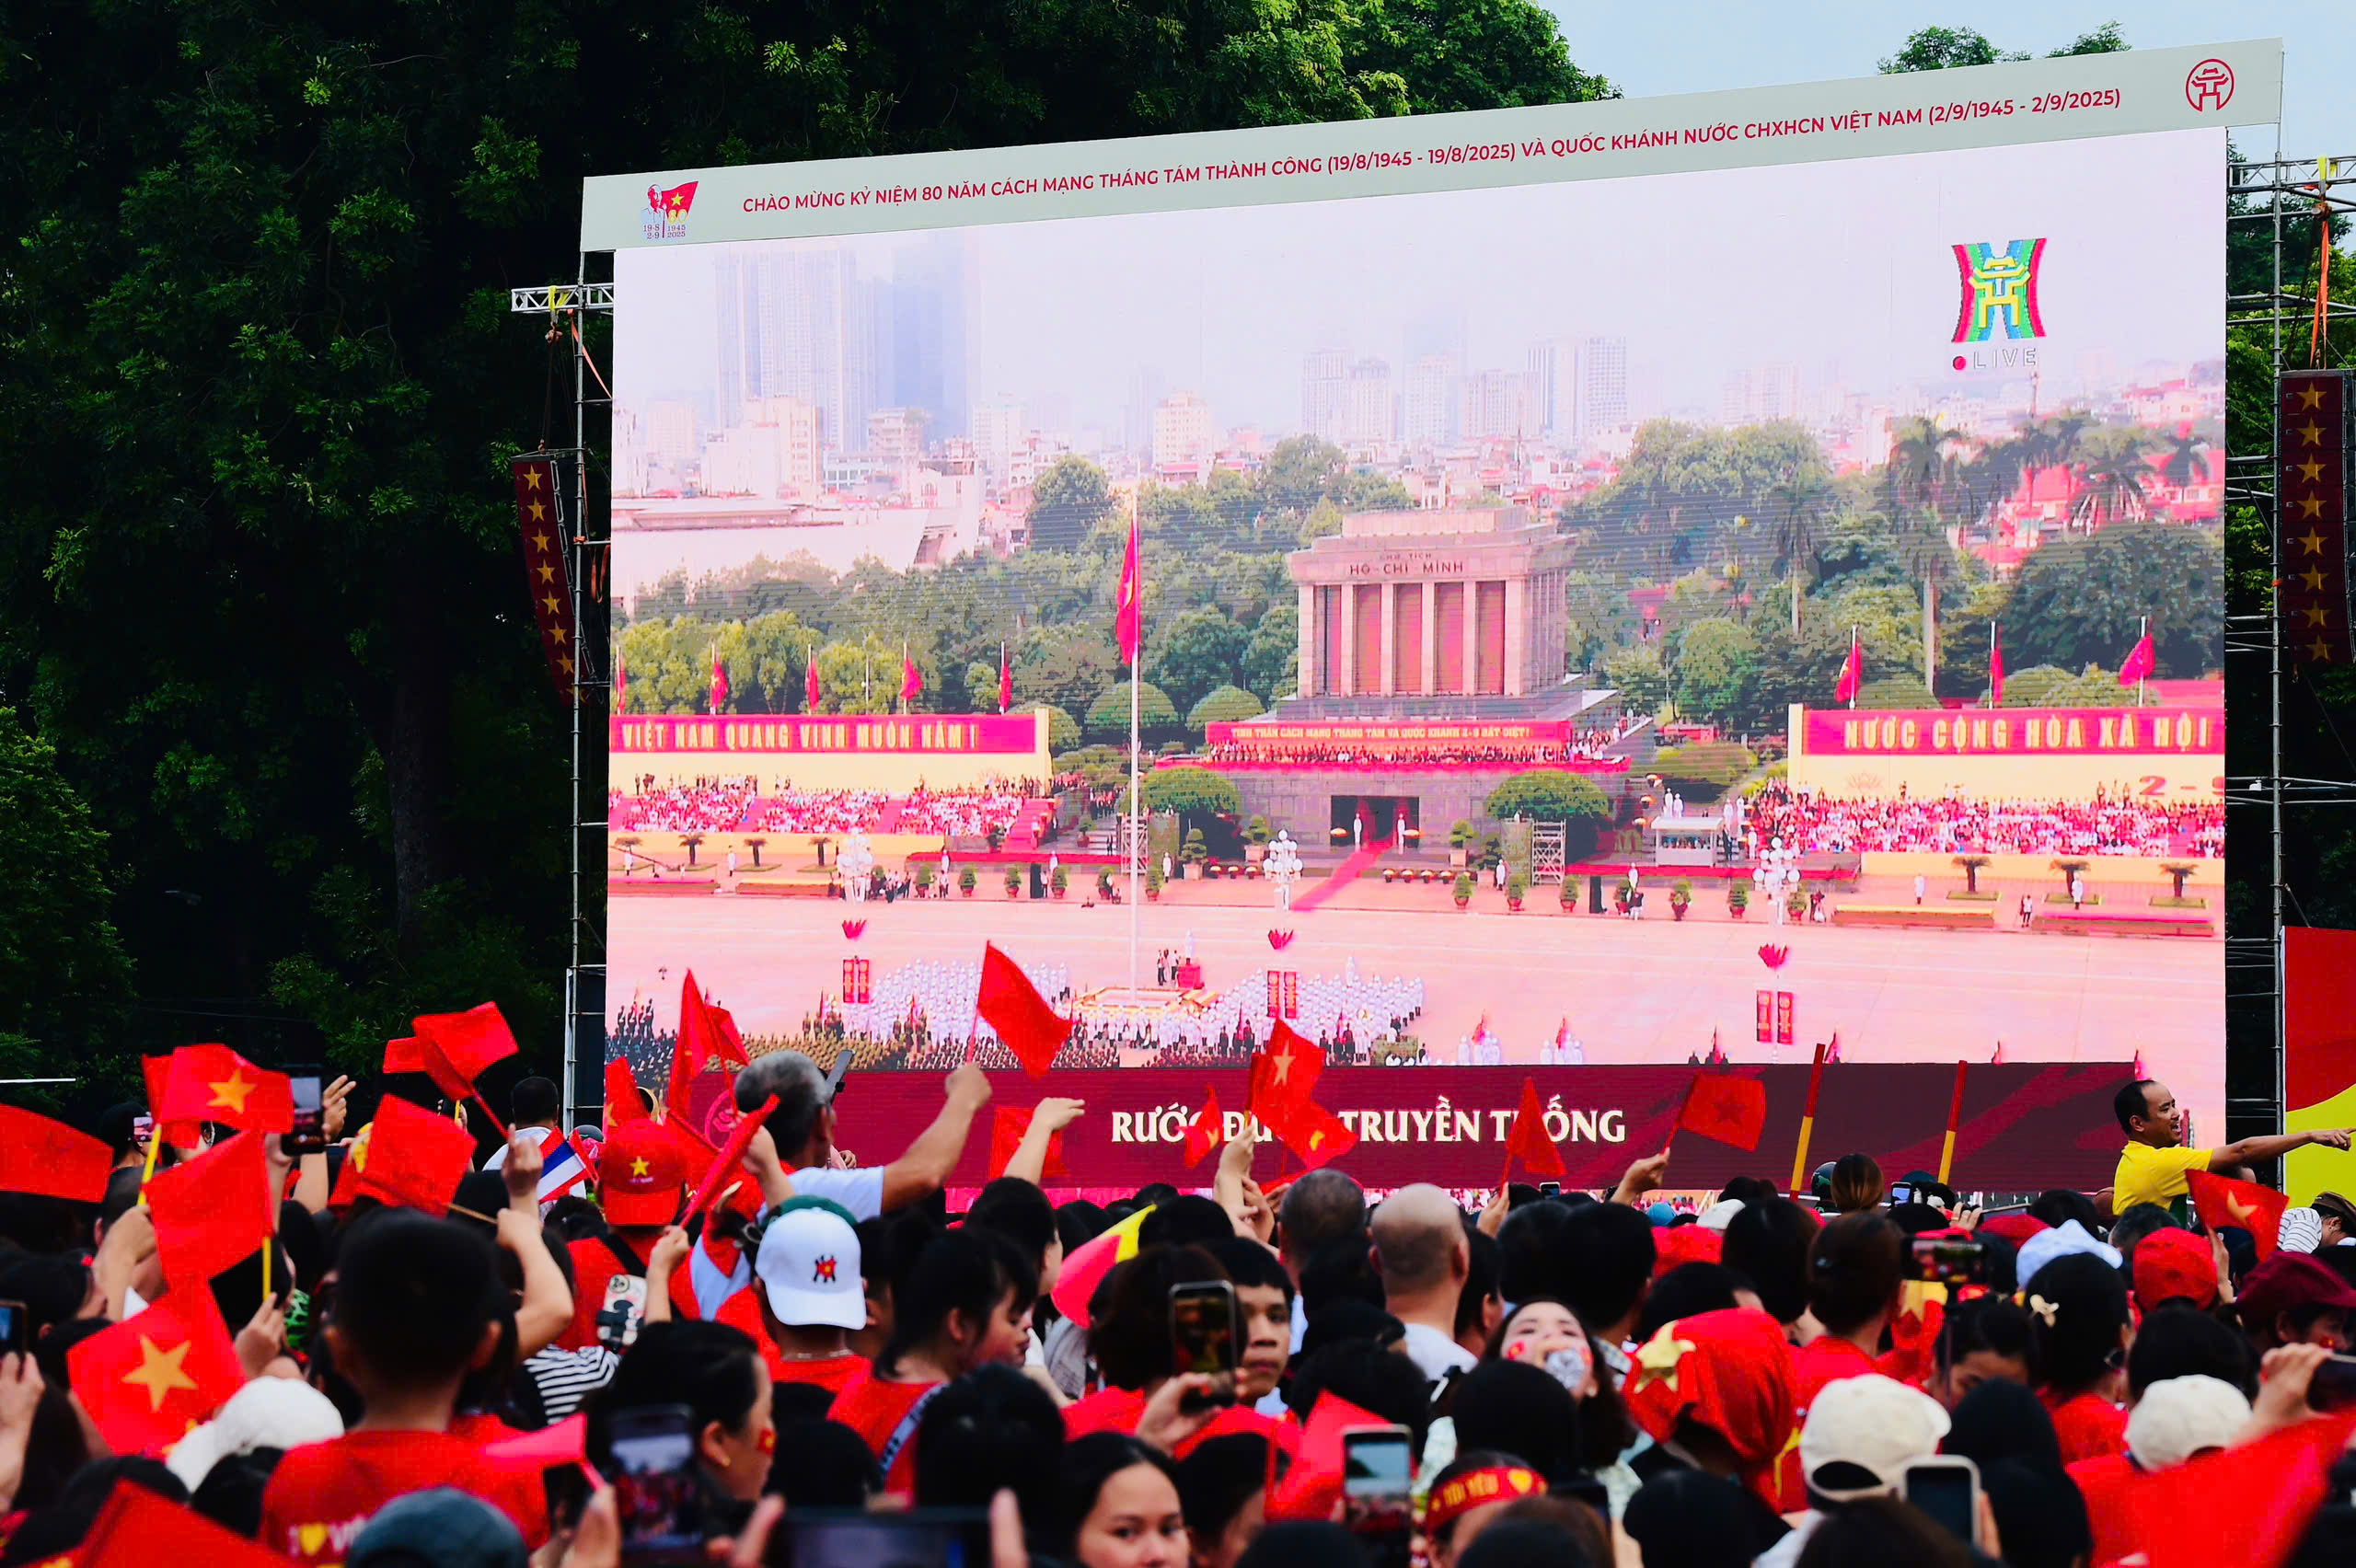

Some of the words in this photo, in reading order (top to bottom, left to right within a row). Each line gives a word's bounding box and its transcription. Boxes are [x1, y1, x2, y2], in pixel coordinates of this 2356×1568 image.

[743, 193, 791, 213] CHÀO
[795, 190, 845, 209] MỪNG
[850, 185, 872, 205] KỶ
[875, 184, 918, 206] NIỆM
[922, 185, 943, 202] 80
[948, 179, 986, 200] NĂM
[990, 177, 1037, 197] CÁCH
[1043, 174, 1094, 195] MẠNG
[1099, 168, 1159, 190] THÁNG
[1164, 164, 1200, 184] TÁM
[1206, 159, 1266, 181] THÀNH
[1272, 156, 1322, 175] CÔNG
[1328, 151, 1412, 175] (19/8/1945
[1428, 142, 1517, 166] 19/8/2025)
[1521, 137, 1546, 157] VÀ
[1551, 132, 1605, 156] QUỐC
[1611, 128, 1678, 151] KHÁNH
[1684, 121, 1738, 145] NƯỚC
[1744, 116, 1824, 139] CHXHCN
[1830, 110, 1873, 133] VIỆT
[1877, 108, 1923, 127] NAM
[1928, 98, 2015, 126] (2/9/1945
[2031, 87, 2121, 114] 2/9/2025)
[1973, 348, 2037, 369] LIVE
[622, 720, 665, 752] VIỆT
[675, 723, 716, 748] NAM
[724, 723, 791, 750] QUANG
[799, 723, 848, 749] VINH
[856, 721, 911, 749] MUÔN
[1844, 715, 1917, 749] NƯỚC
[1933, 714, 2008, 754] CỘNG
[2026, 713, 2084, 749] HÒA
[2098, 713, 2136, 748] XÃ
[2154, 711, 2209, 753] HỘI
[1337, 1094, 1481, 1143] TRUYỀN
[1489, 1094, 1625, 1143] TỐNG
